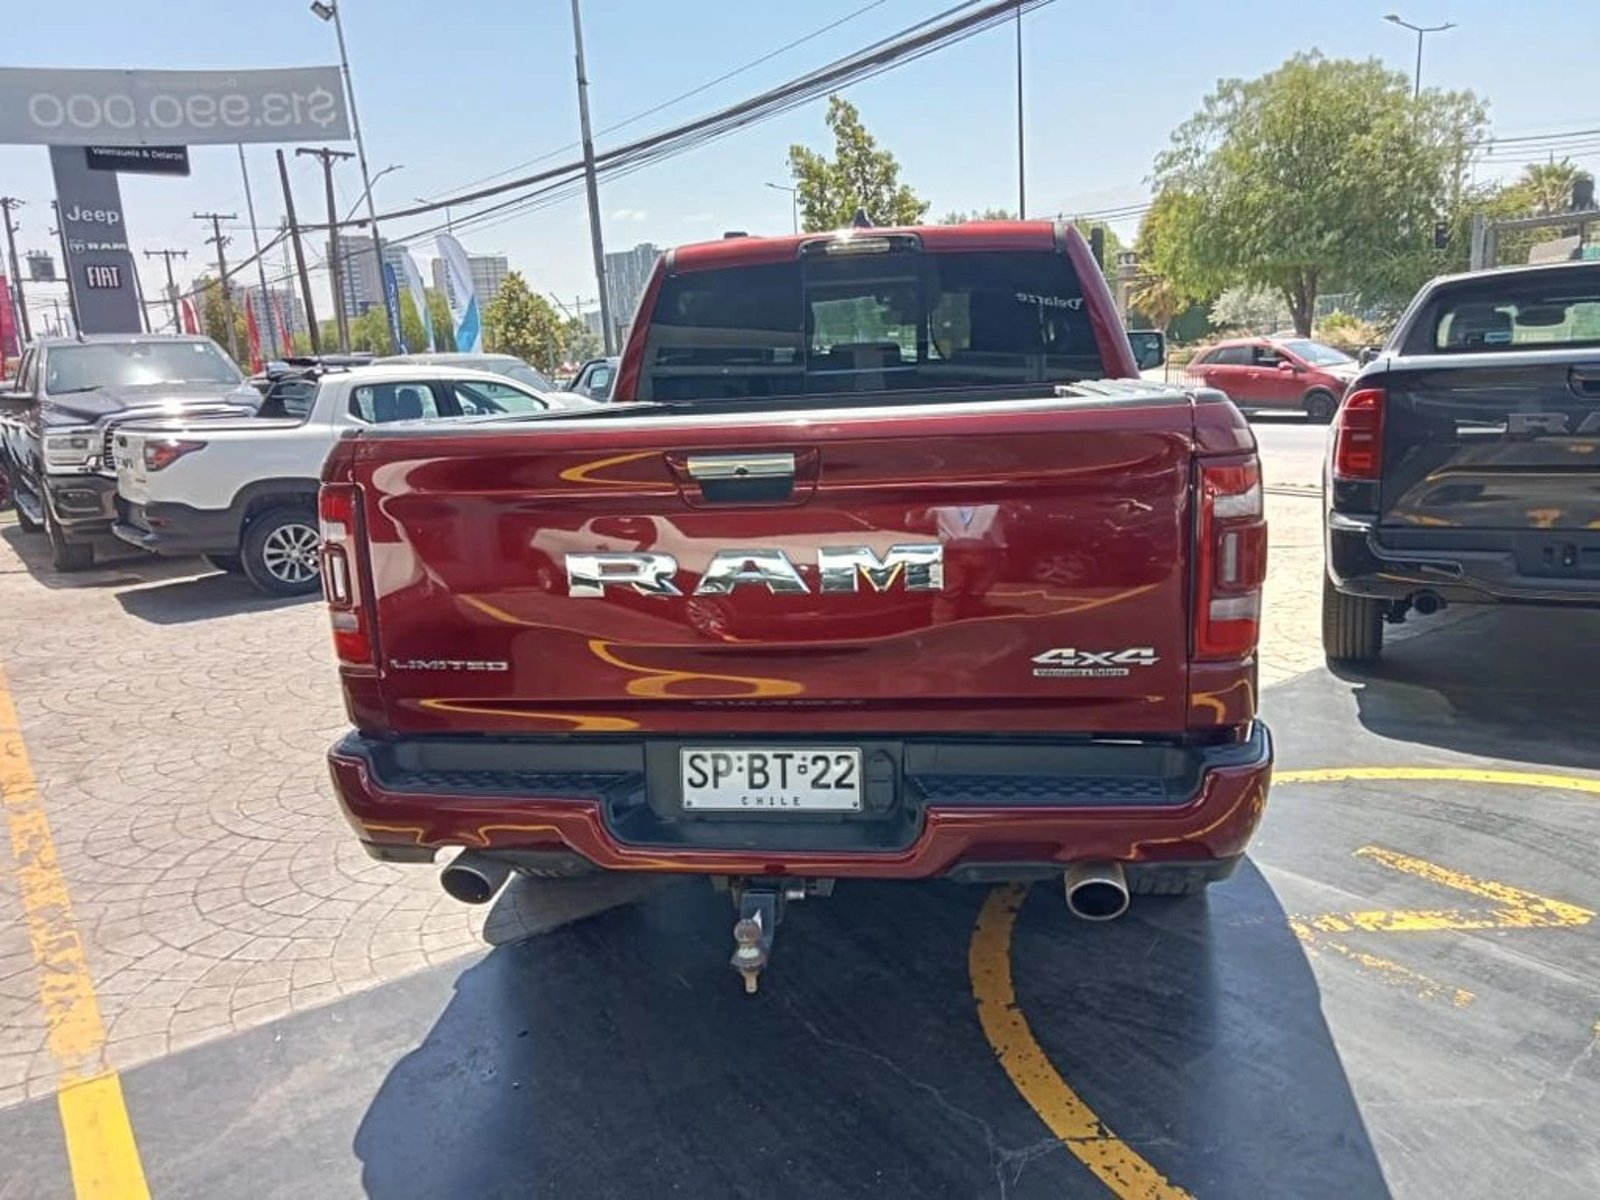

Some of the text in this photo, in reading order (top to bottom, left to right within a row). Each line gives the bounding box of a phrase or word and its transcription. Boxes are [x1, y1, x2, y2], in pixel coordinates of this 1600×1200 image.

[66, 205, 120, 226] Jeep
[87, 242, 127, 251] RAM
[87, 266, 120, 287] FIAT
[565, 544, 944, 598] RAM
[390, 659, 509, 672] LIMITED
[1031, 648, 1160, 666] 4x4
[740, 796, 802, 806] CHILE
